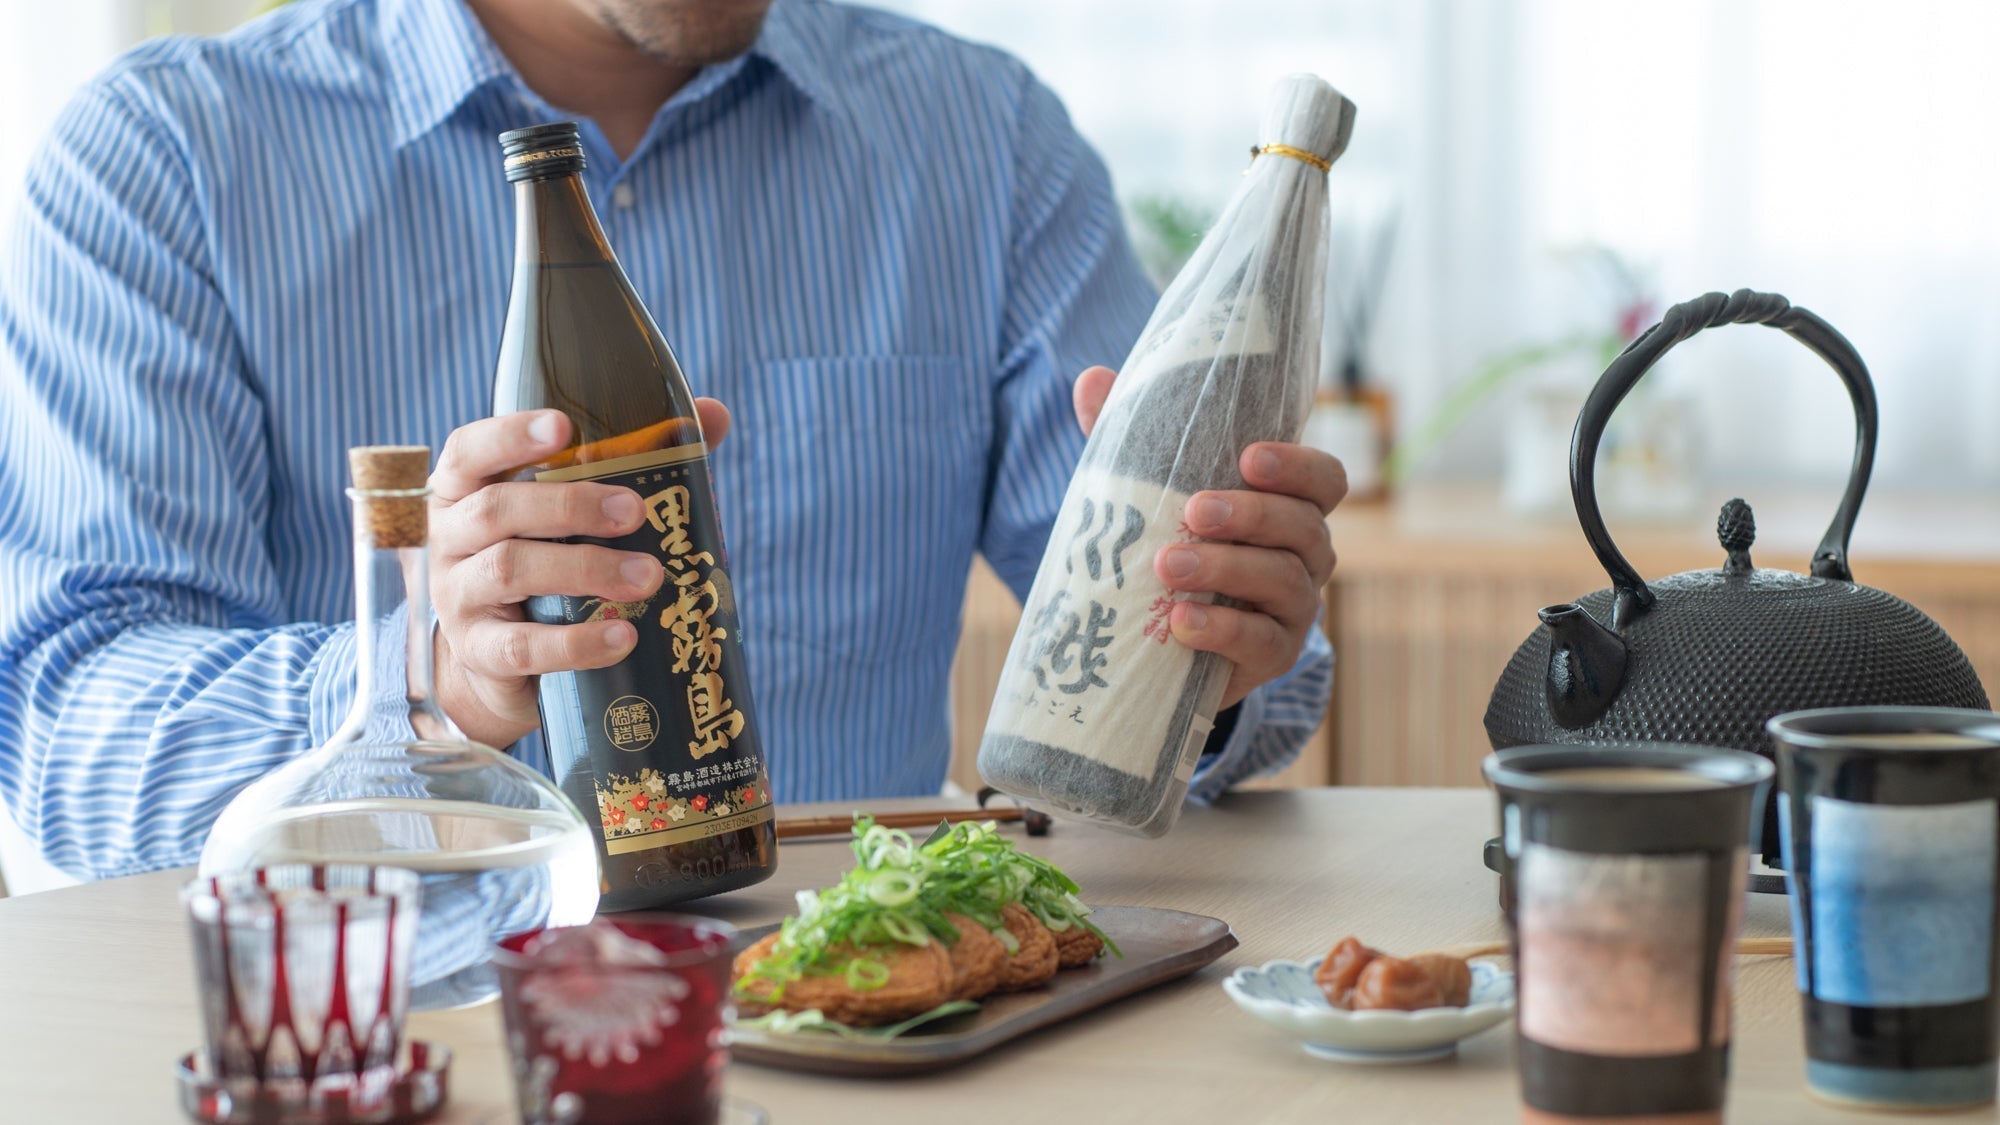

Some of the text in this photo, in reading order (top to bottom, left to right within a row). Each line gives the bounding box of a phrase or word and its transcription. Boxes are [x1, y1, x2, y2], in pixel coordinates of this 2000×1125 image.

[645, 484, 745, 760] 黒霧島
[667, 754, 759, 786] 霧島酒造株式会社
